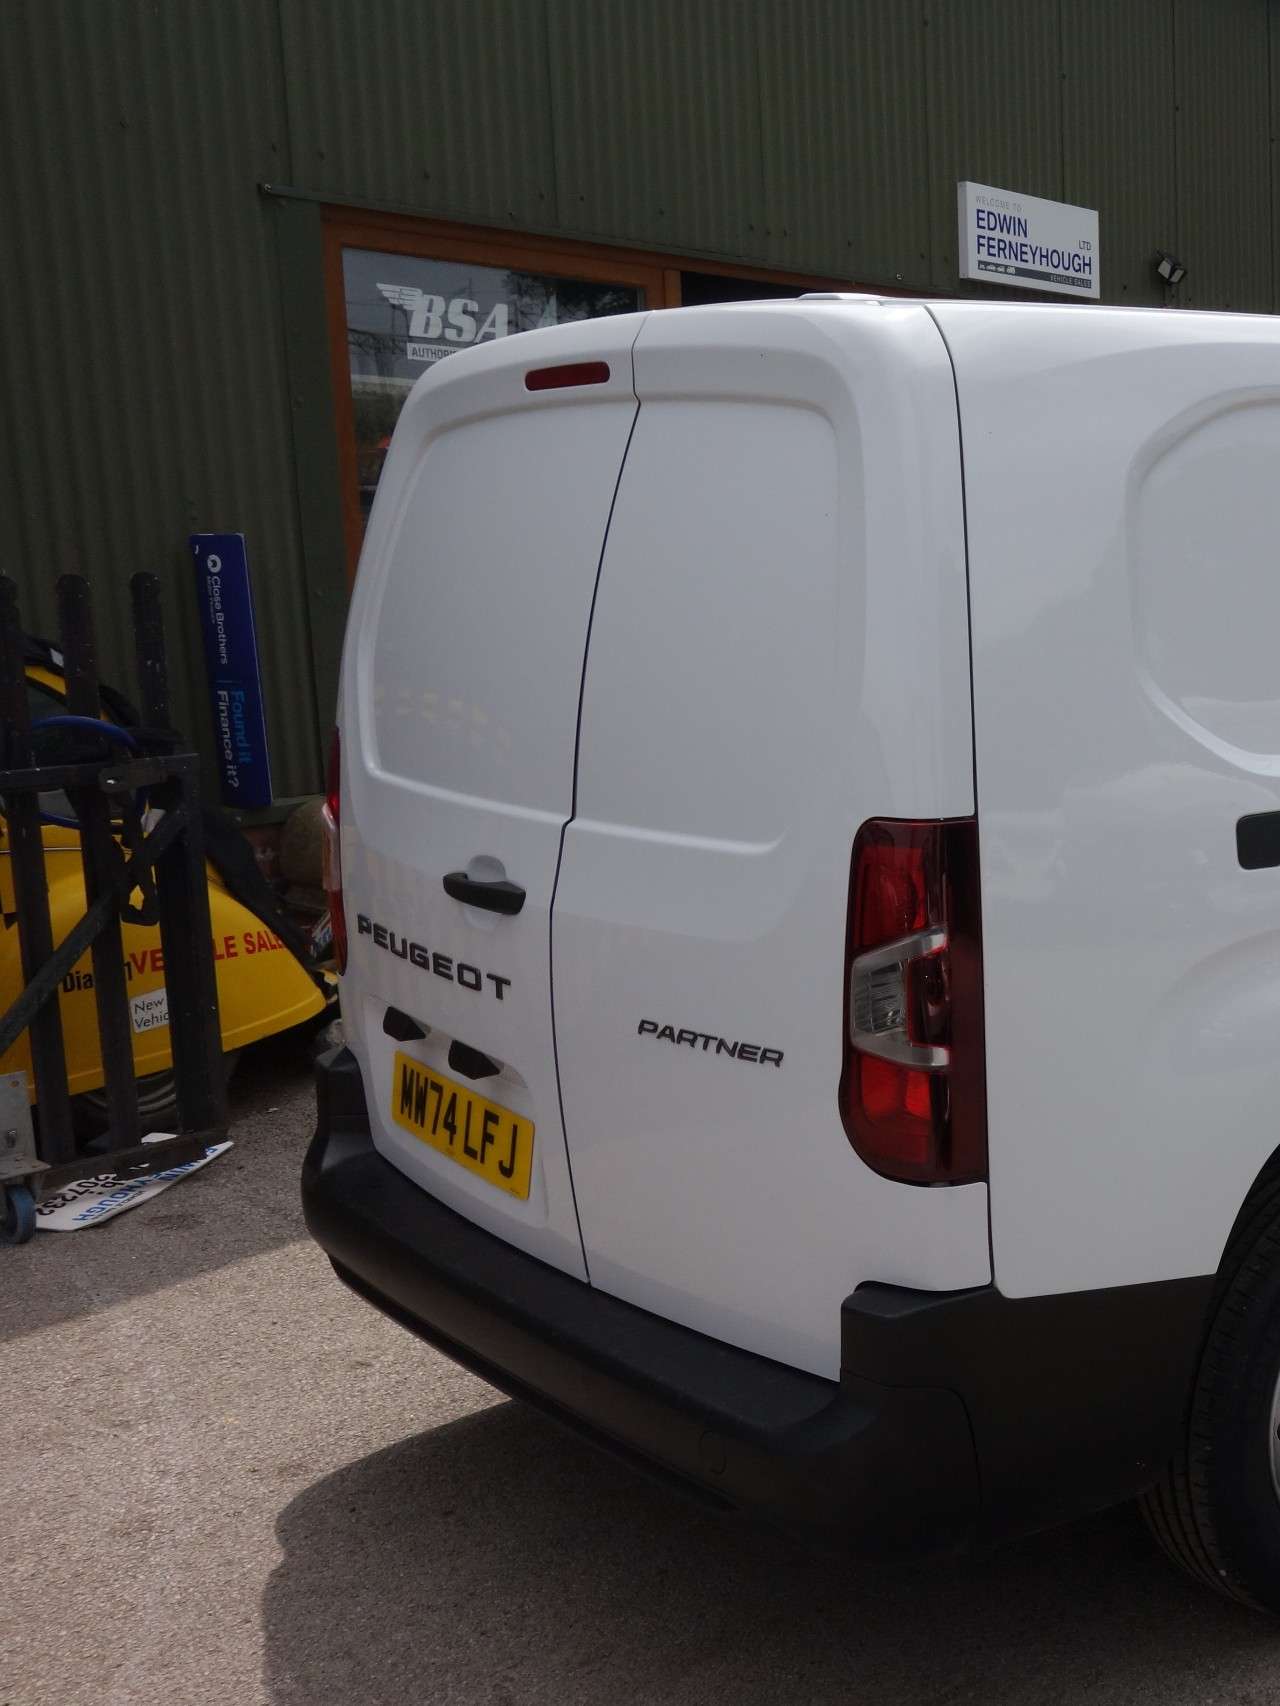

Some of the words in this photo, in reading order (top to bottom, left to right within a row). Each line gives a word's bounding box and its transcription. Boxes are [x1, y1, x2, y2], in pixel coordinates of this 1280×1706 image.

[976, 208, 1028, 238] EDWIN
[1078, 240, 1092, 251] LTD
[976, 234, 1092, 275] FERNEYHOUGH
[408, 294, 508, 343] BSA
[211, 575, 221, 610] Close
[216, 612, 228, 665] Brothers
[217, 690, 233, 761] Finance
[226, 764, 240, 789] it?
[231, 690, 251, 748] Found
[357, 913, 511, 1000] PEUGEOT
[134, 997, 164, 1013] New
[637, 1019, 784, 1068] PARTNER
